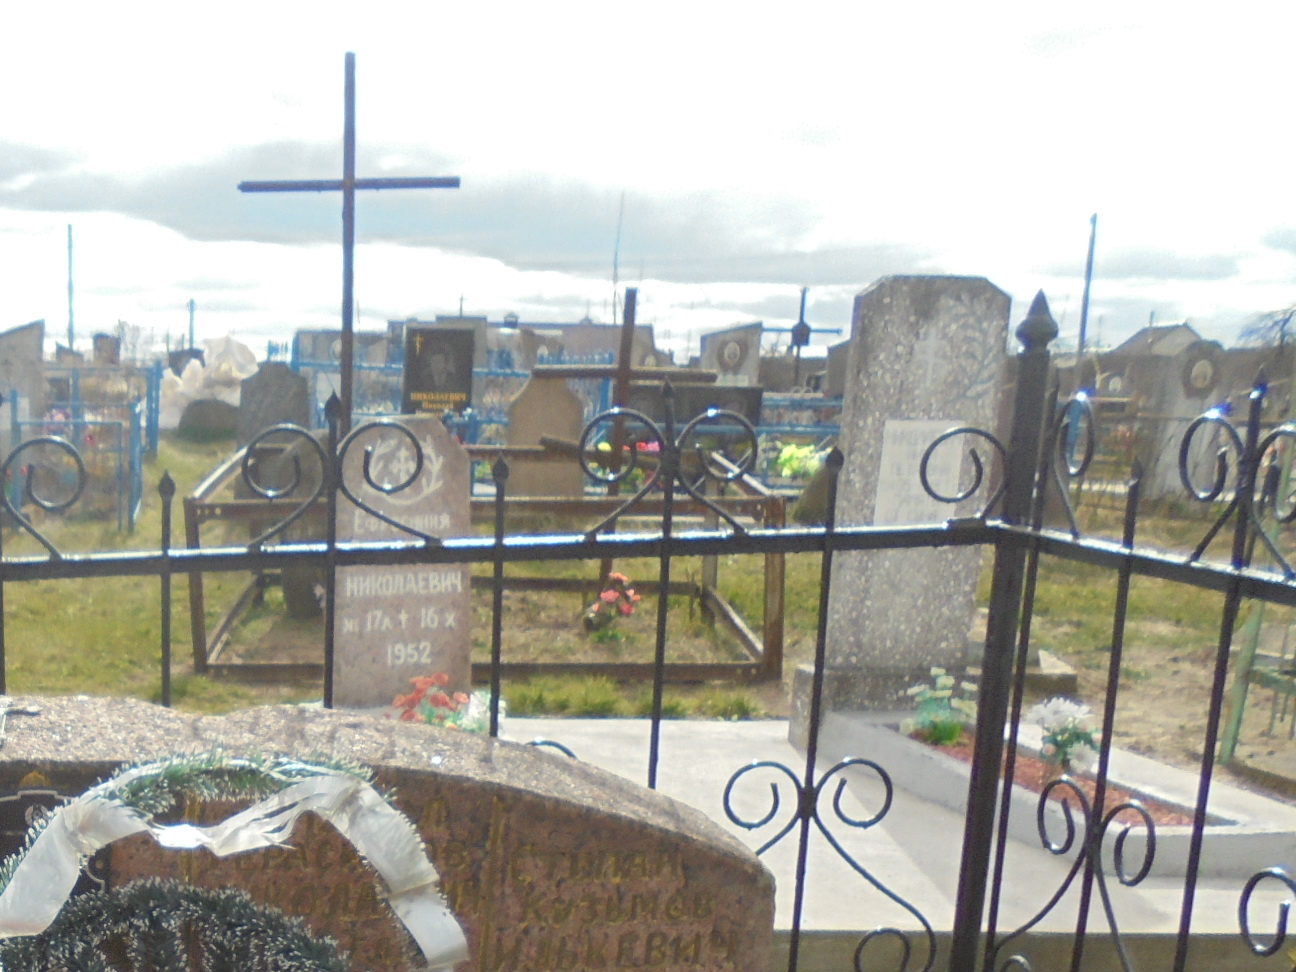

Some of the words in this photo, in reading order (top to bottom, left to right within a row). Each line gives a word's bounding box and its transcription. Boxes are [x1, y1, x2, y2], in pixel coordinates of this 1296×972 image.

[346, 571, 462, 597] НИКОЛАЕВИЧ
[421, 607, 439, 628] 16
[387, 641, 432, 667] 1952
